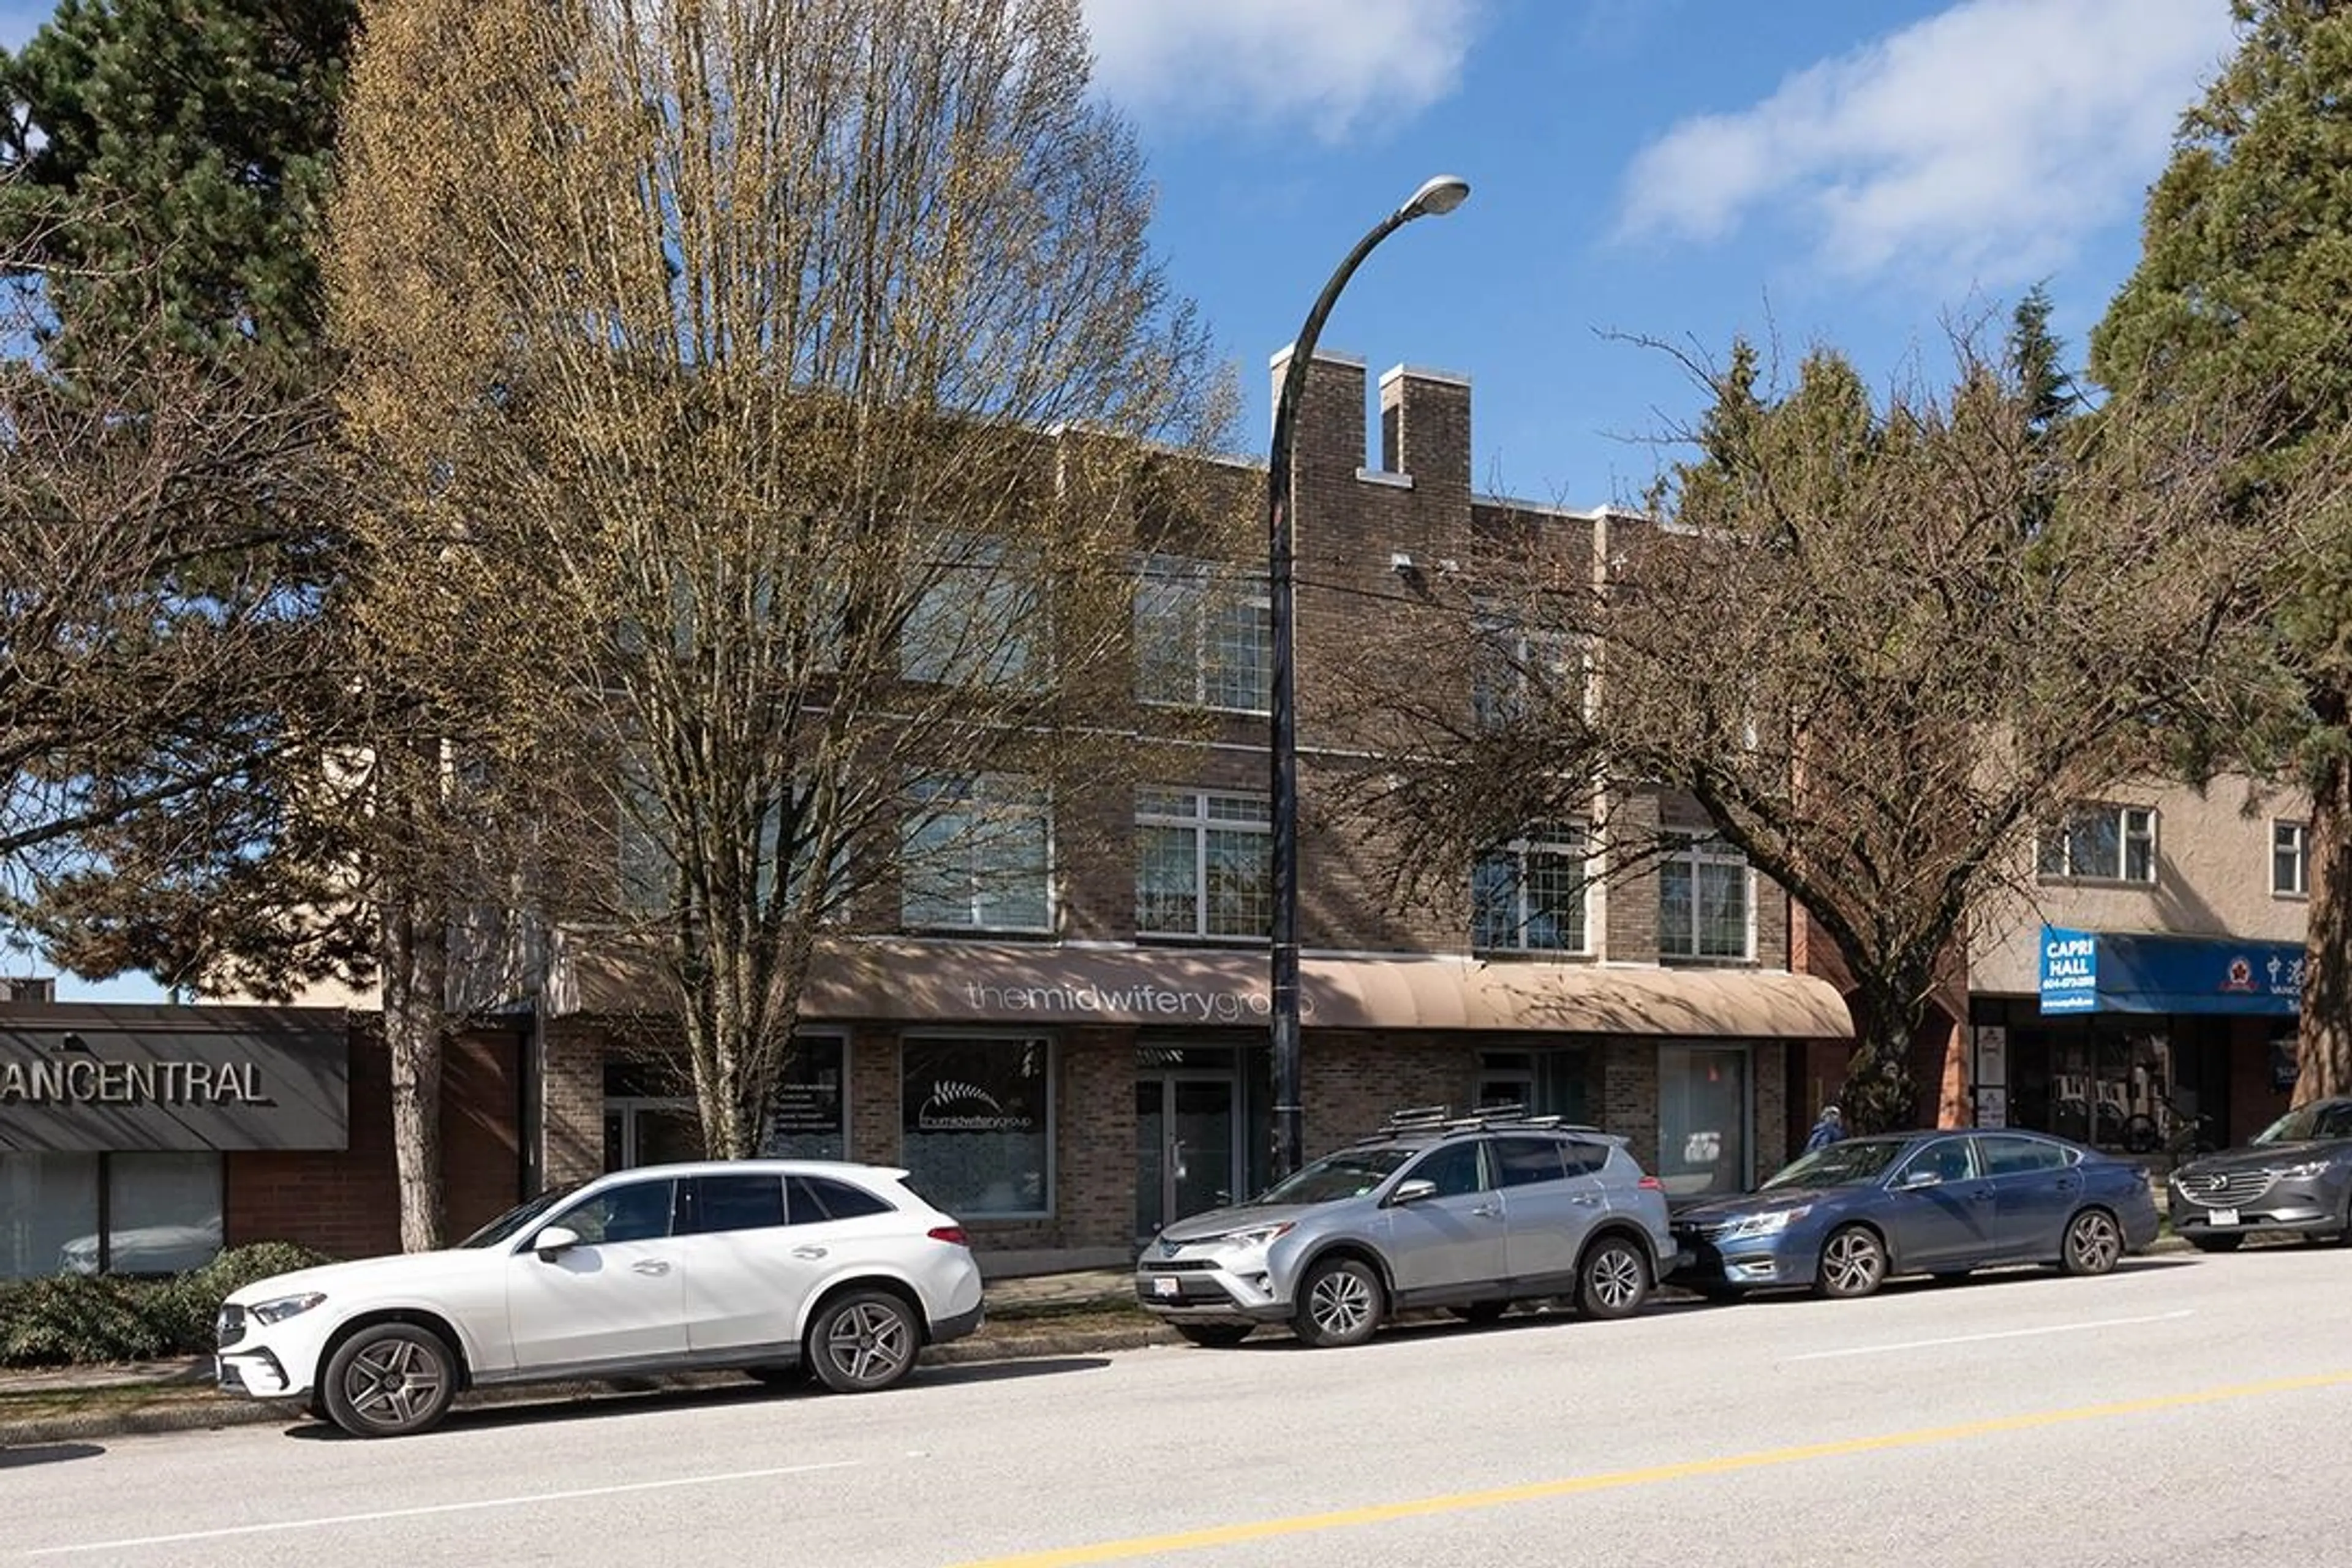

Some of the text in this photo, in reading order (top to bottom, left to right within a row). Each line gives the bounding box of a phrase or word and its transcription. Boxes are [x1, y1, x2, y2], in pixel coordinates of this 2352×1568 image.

[2047, 939, 2094, 959] CAPRI
[2049, 958, 2089, 976] HALL
[967, 982, 1315, 1022] themidwiferygrop
[0, 1060, 270, 1101] ANCENTRAL
